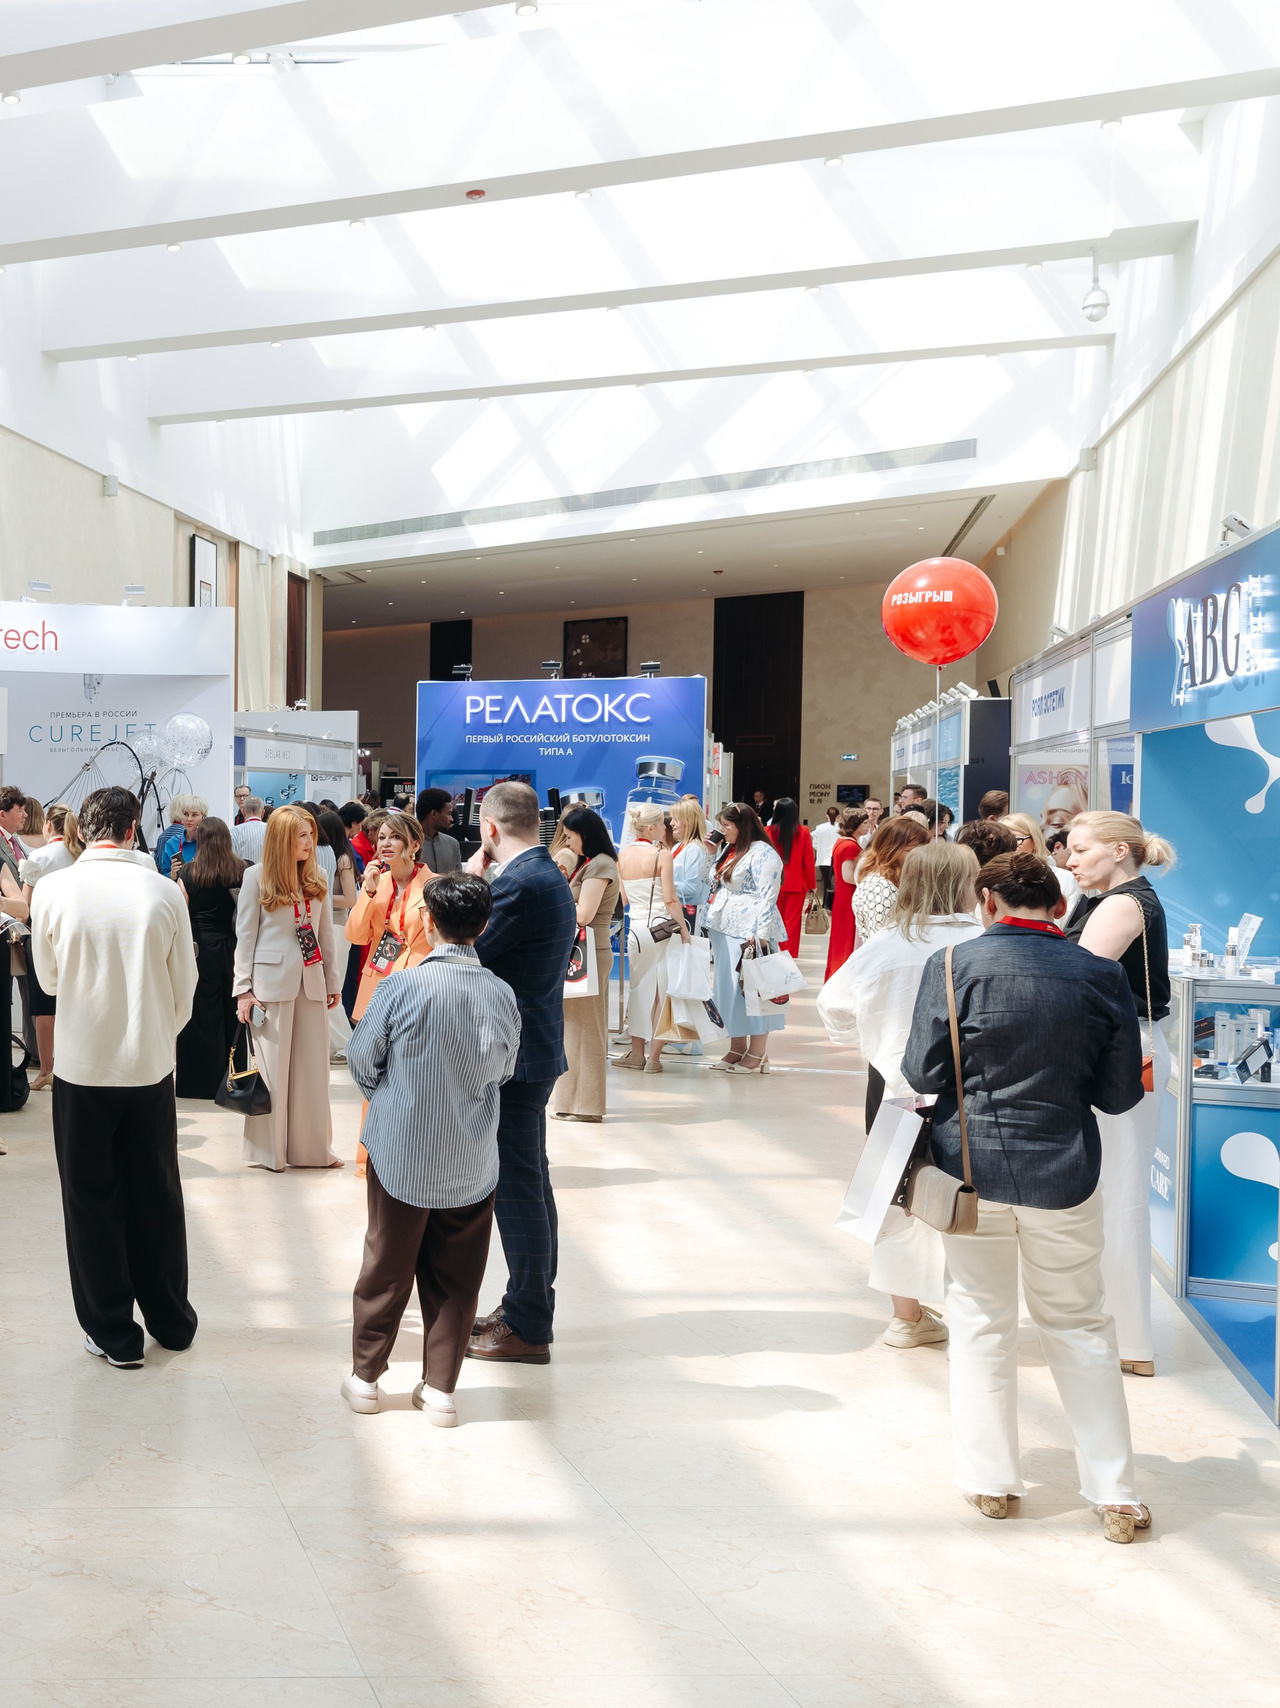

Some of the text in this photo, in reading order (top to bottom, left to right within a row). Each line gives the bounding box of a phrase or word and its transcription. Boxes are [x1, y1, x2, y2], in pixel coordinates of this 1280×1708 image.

[891, 590, 953, 606] РОЗЫГРЫШ
[103, 710, 138, 718] РОССИИ
[466, 693, 651, 724] РЕЛАТОКС
[466, 733, 650, 743] ПЕРВЫЙ РОССИЙСКИЙ БОТУЛОТОКСИН
[539, 748, 564, 756] ТИПА
[1150, 1164, 1170, 1202] CARE
